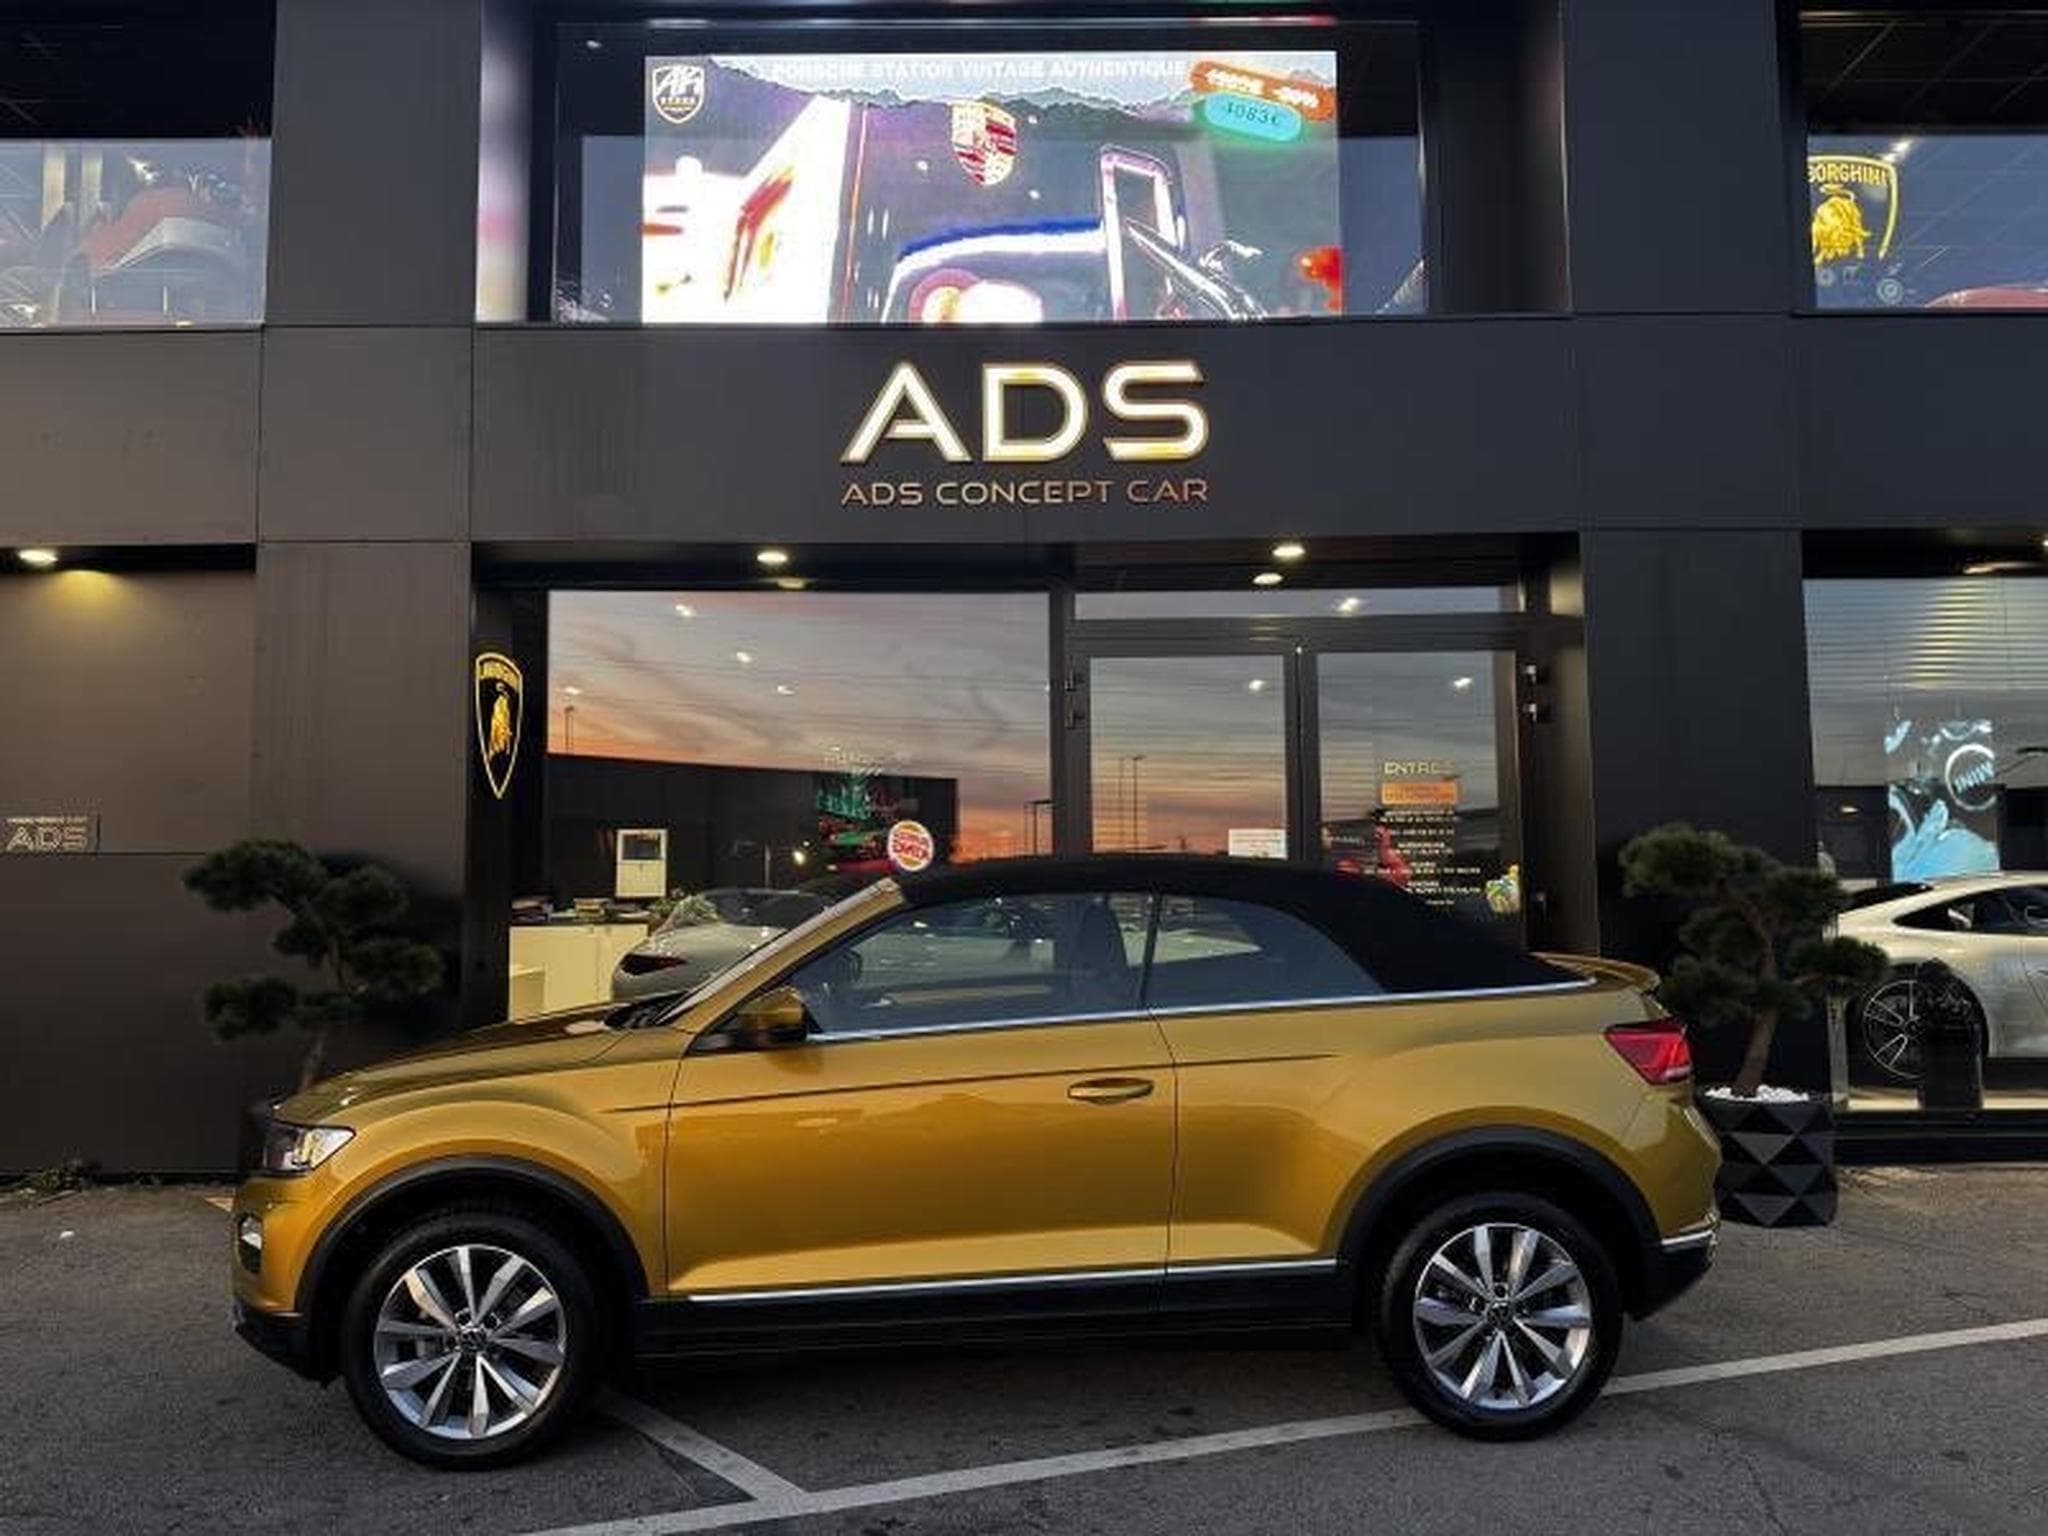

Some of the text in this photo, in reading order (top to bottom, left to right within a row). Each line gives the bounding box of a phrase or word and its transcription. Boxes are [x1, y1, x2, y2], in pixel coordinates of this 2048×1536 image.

[961, 61, 1044, 79] VINTAGE
[840, 360, 1209, 462] ADS
[840, 479, 1209, 506] ADS CONCEPT CAR
